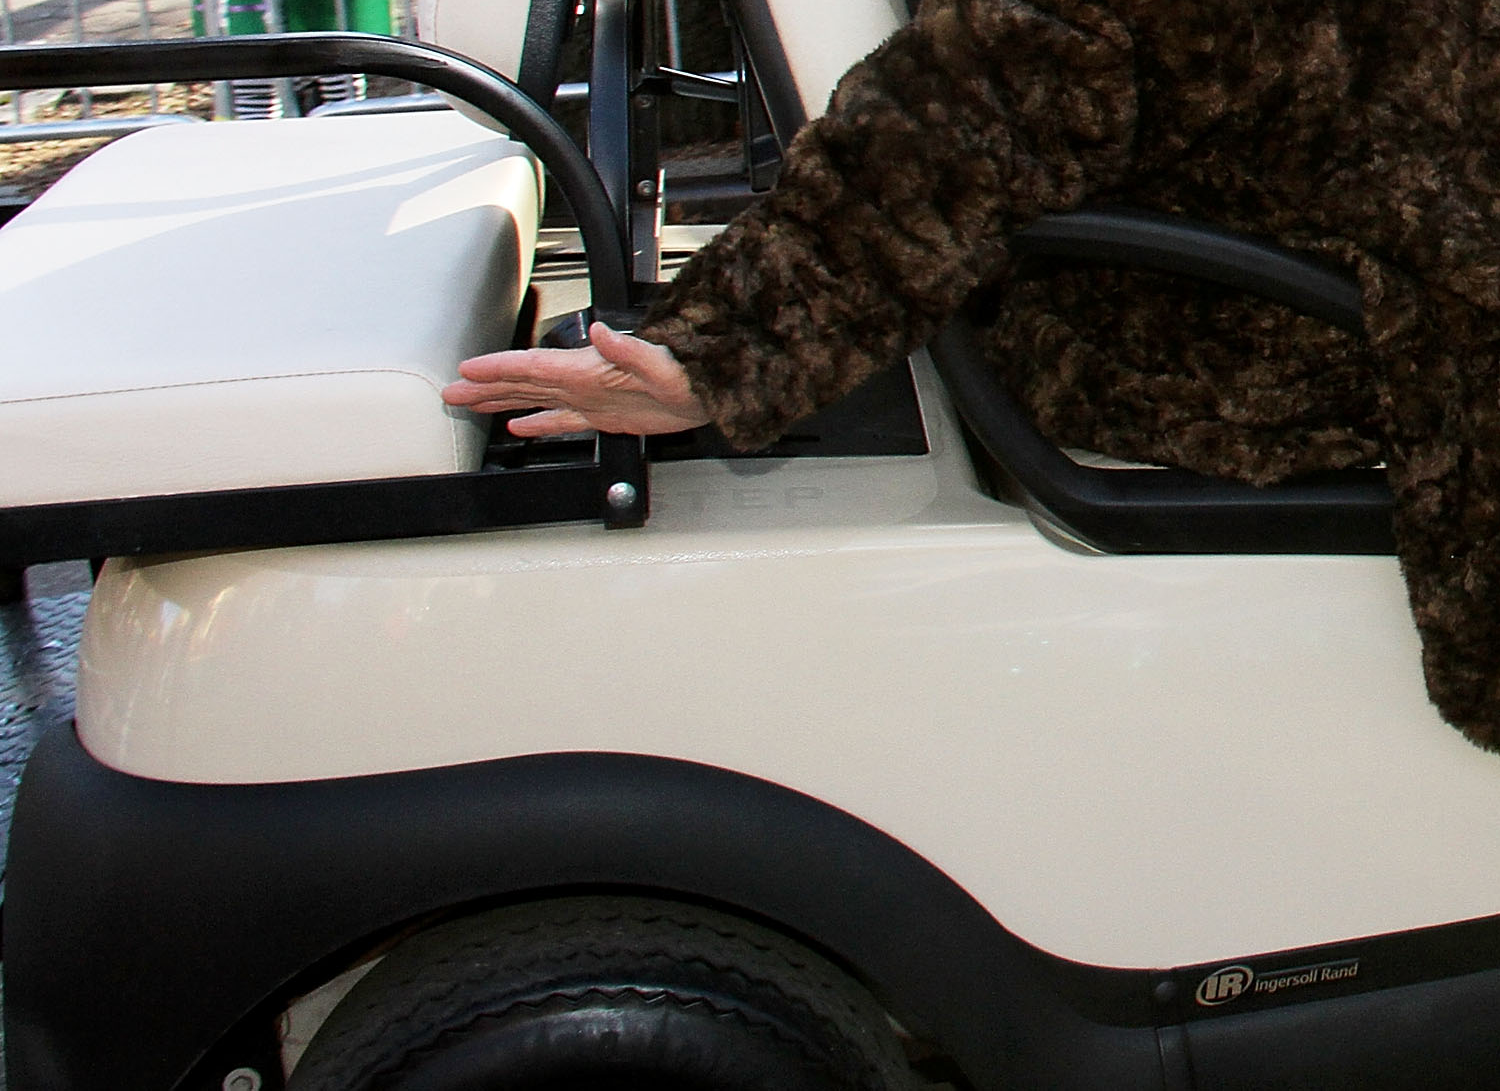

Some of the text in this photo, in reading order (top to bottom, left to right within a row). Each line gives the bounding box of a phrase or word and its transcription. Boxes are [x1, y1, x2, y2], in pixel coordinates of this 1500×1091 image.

[1205, 972, 1244, 1000] IR
[1254, 962, 1359, 993] Ingersoll Rand
